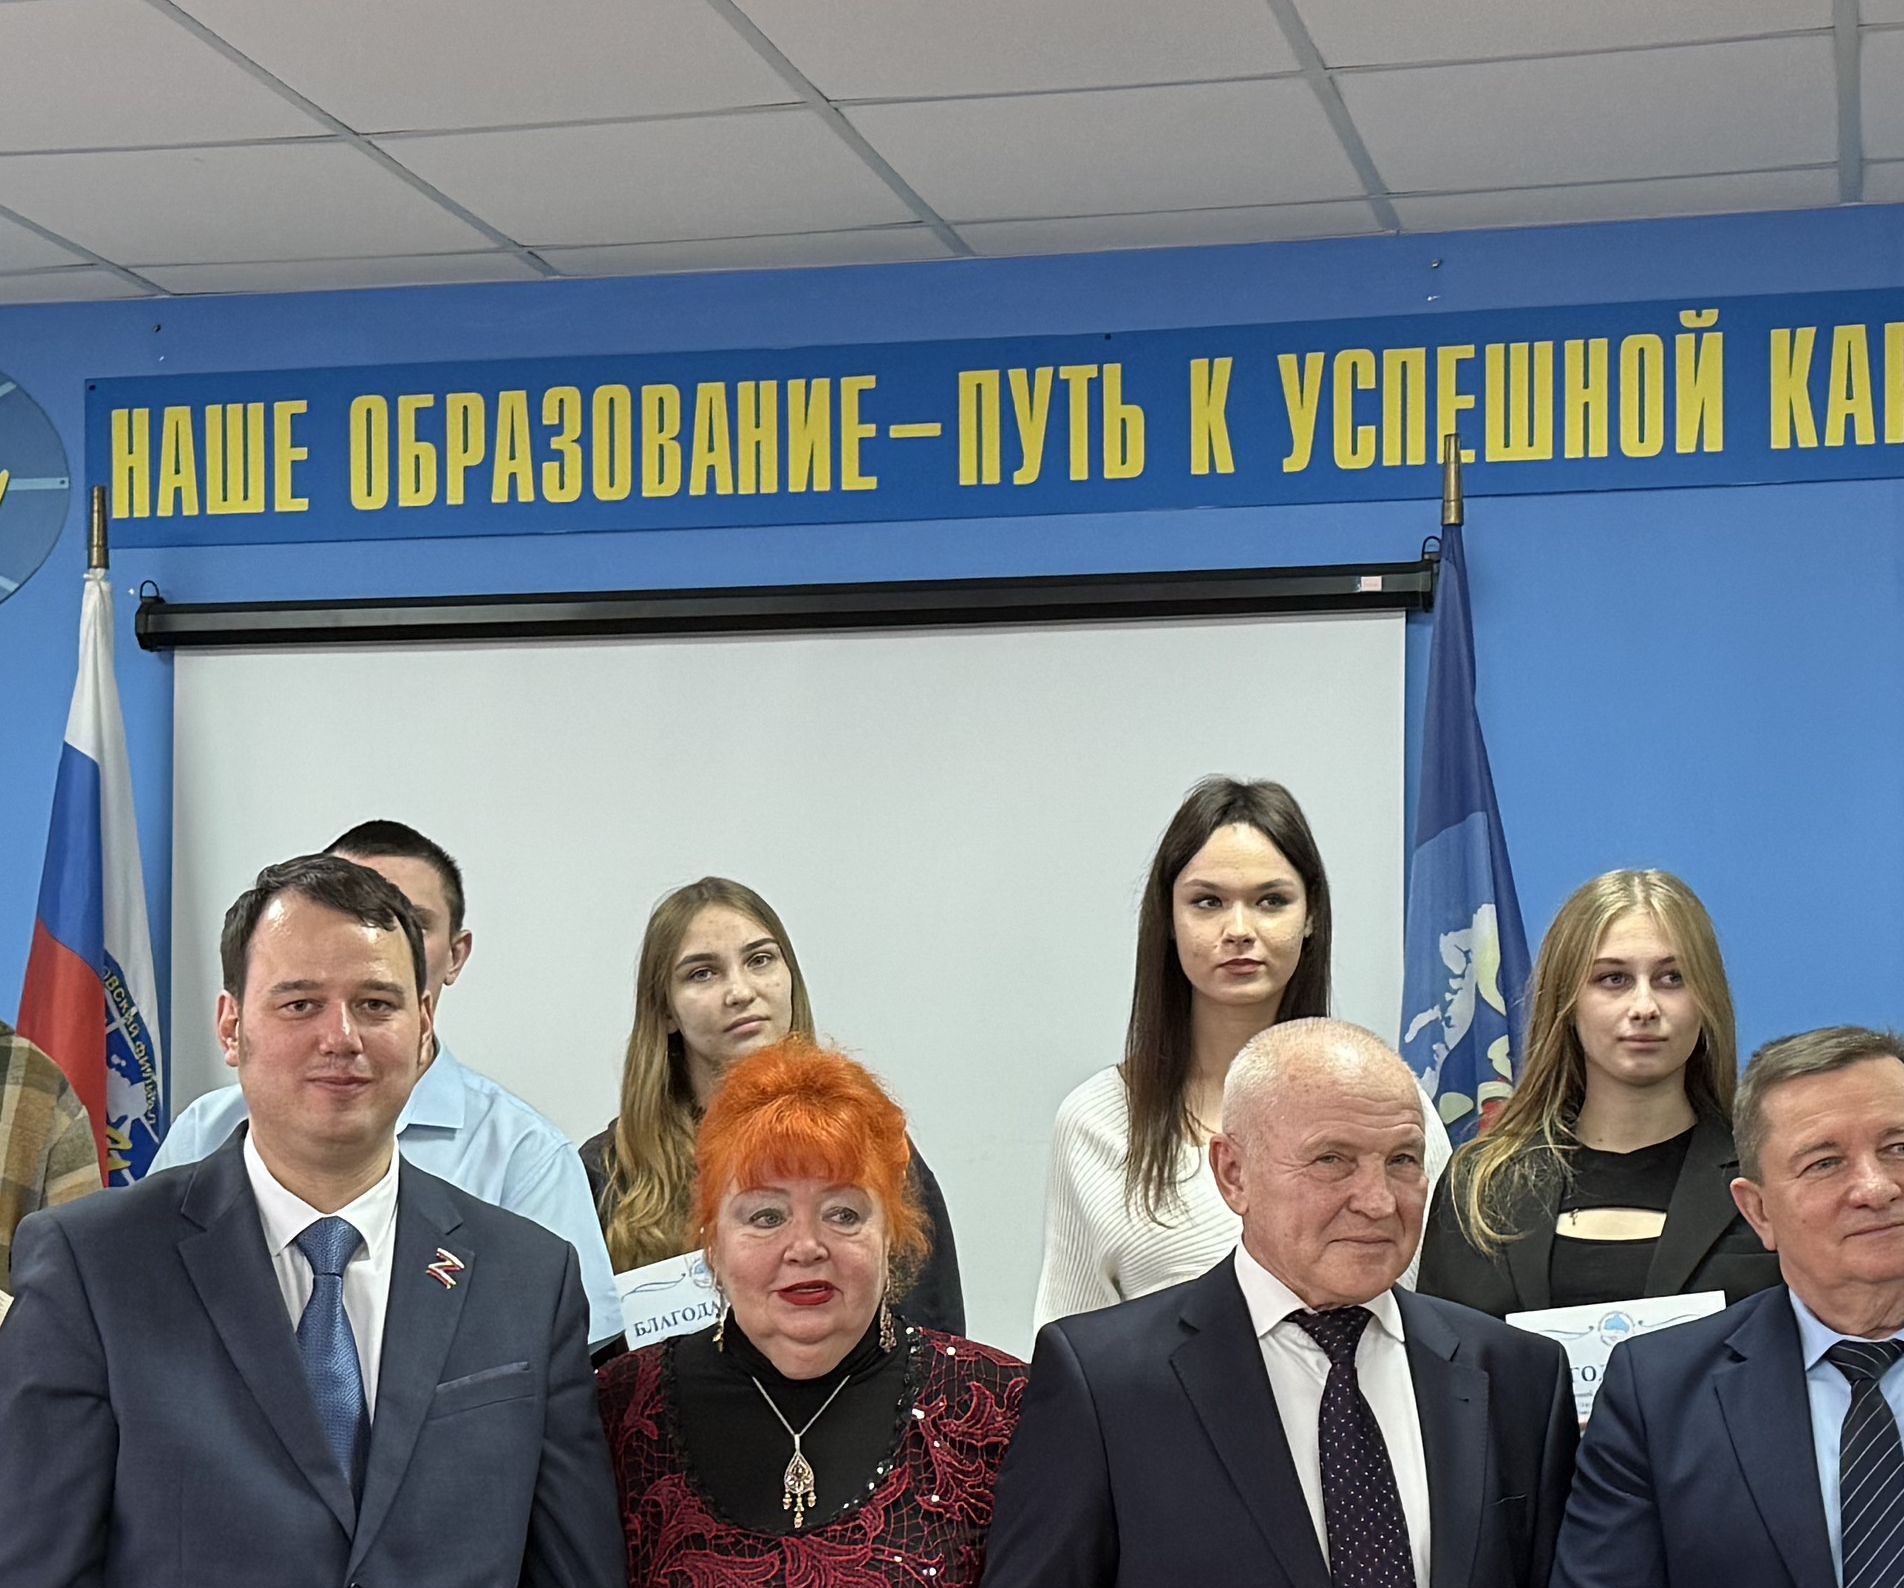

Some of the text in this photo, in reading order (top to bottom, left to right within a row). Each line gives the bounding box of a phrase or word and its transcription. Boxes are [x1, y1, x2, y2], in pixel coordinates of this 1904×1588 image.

[114, 403, 307, 518] НАШЕ
[352, 378, 876, 509] ОБРАЗОВАНИЕ
[960, 366, 1144, 485] ПУТЬ
[1192, 360, 1233, 474] К
[1280, 309, 1725, 472] УСПЕШНОЙ
[633, 1300, 721, 1338] БЛАГОДА
